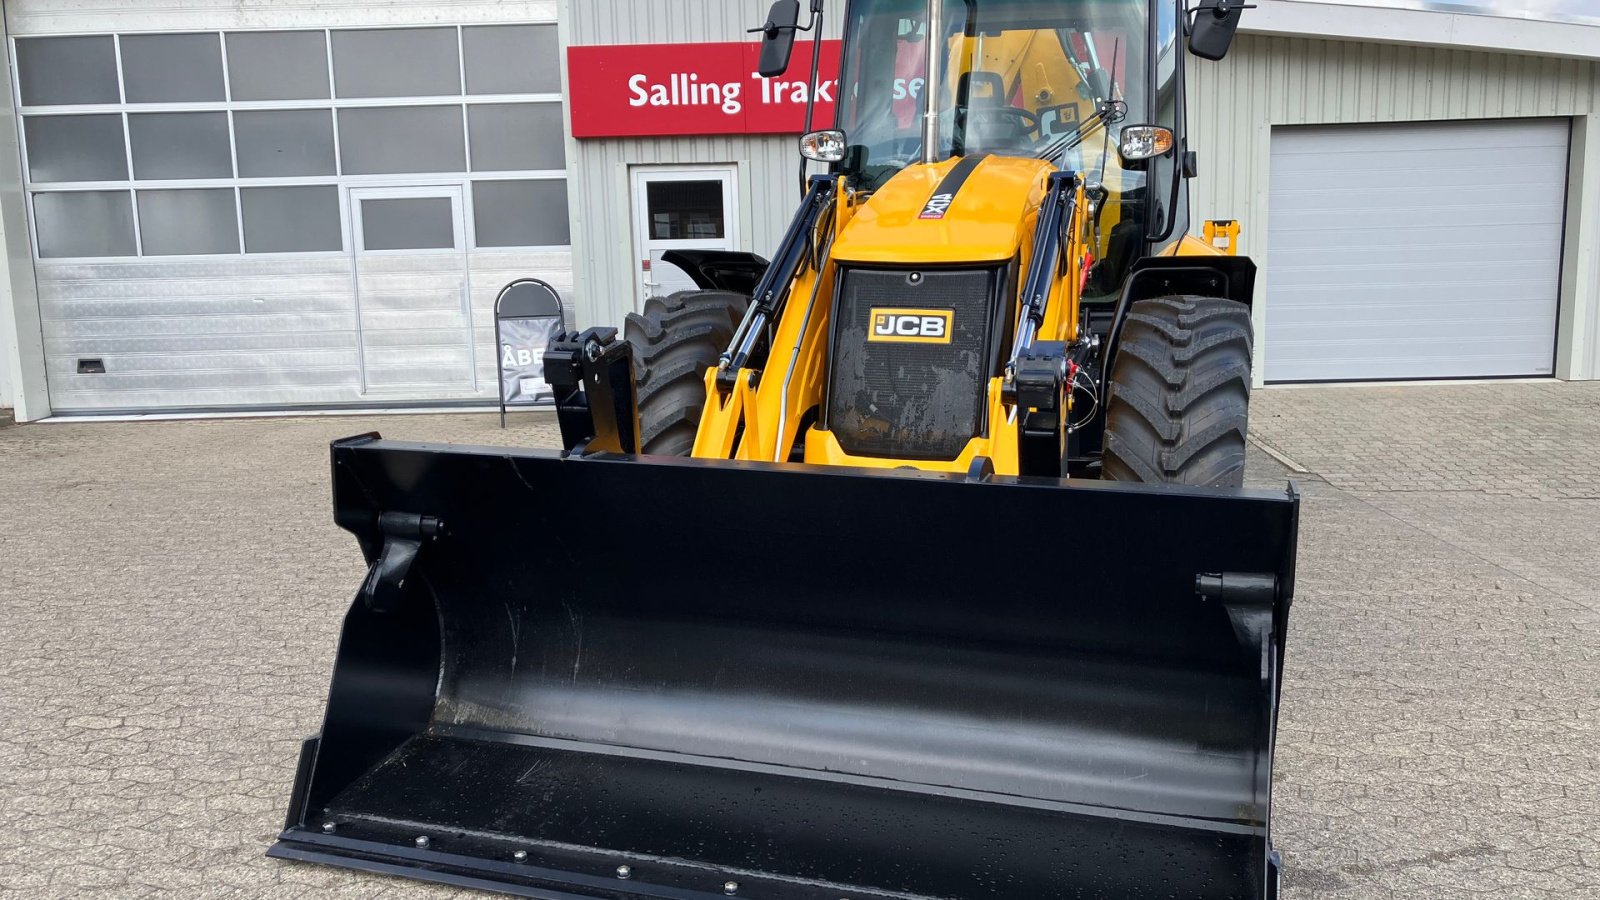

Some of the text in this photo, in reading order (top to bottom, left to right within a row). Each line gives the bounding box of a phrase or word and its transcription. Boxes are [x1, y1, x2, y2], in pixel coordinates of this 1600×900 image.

[628, 73, 741, 114] Salling
[876, 315, 945, 336] JCB
[502, 344, 546, 368] ÅBE
